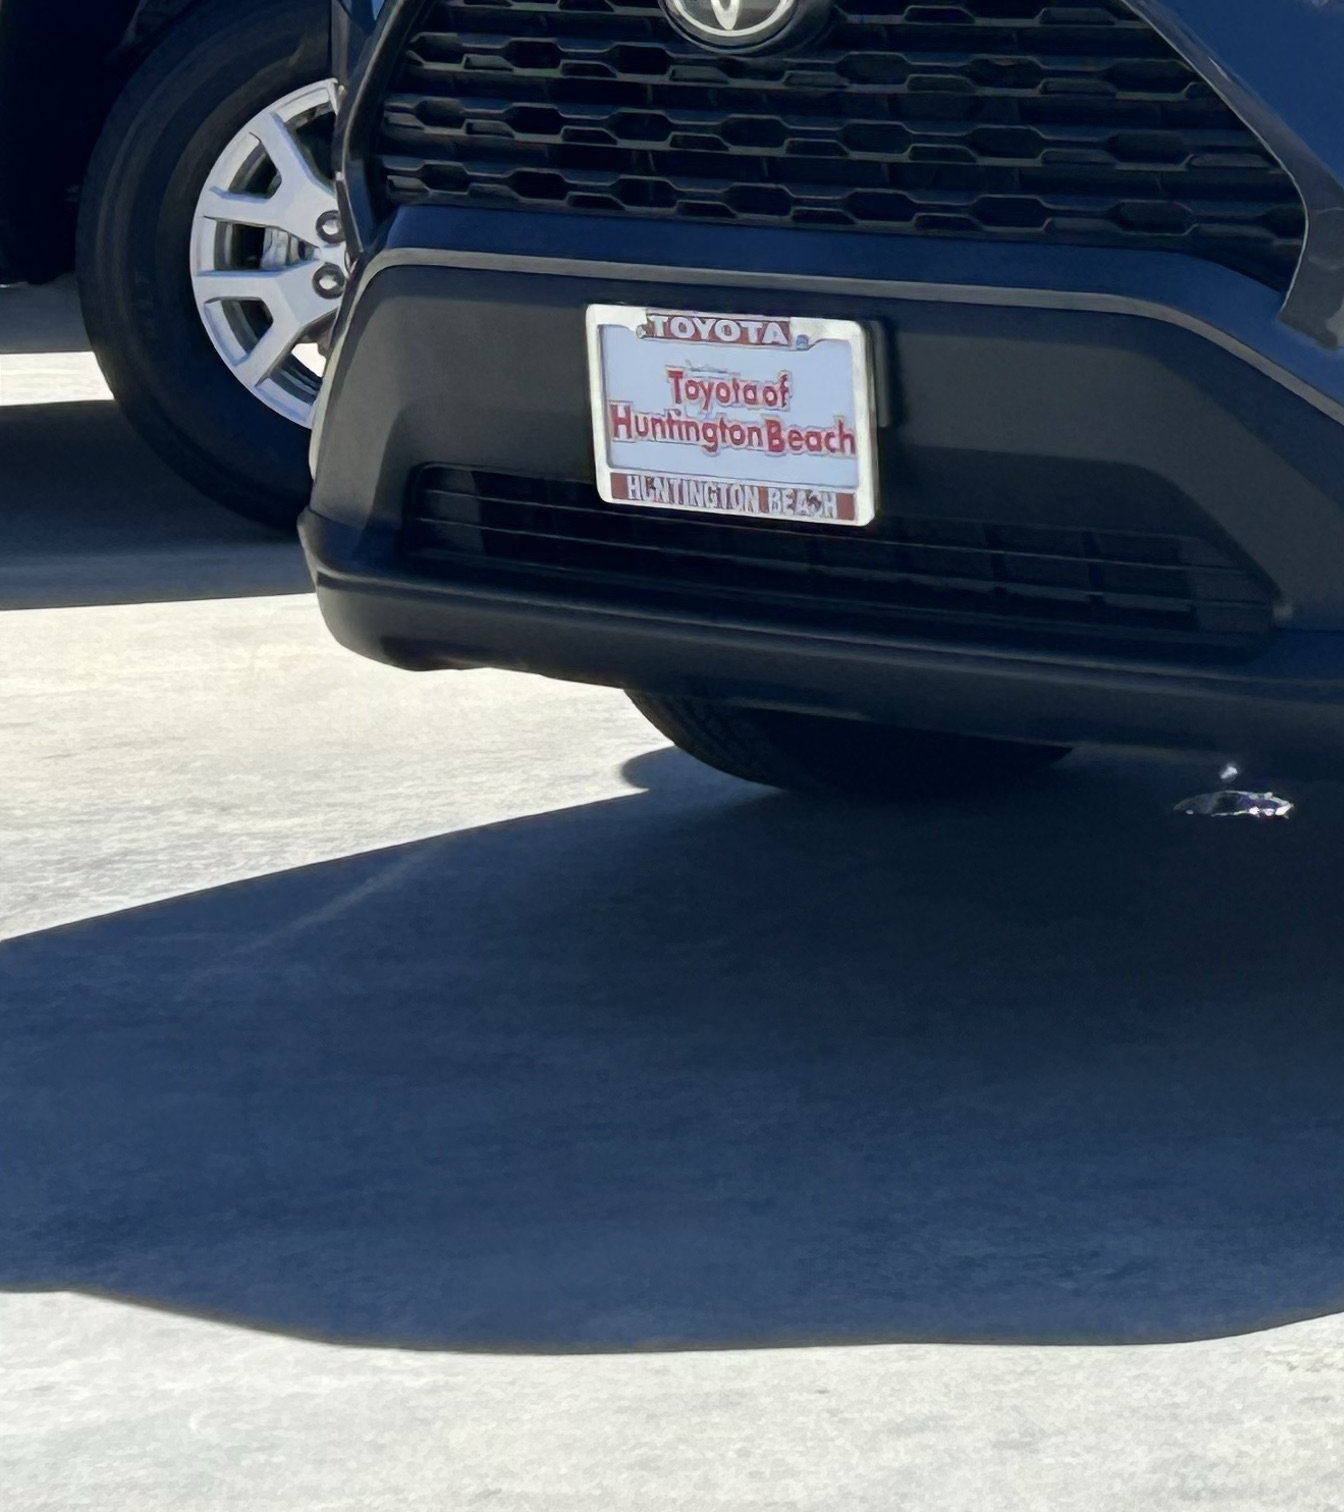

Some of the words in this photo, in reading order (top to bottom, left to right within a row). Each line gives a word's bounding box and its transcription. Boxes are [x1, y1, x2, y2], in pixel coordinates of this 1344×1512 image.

[648, 314, 791, 346] TOYOTA
[666, 369, 758, 411] Toyota
[762, 373, 789, 408] of
[609, 403, 764, 454] Huntington
[764, 418, 857, 454] Beach
[625, 473, 760, 514] HUNTINGTON
[767, 488, 838, 520] BEACH
